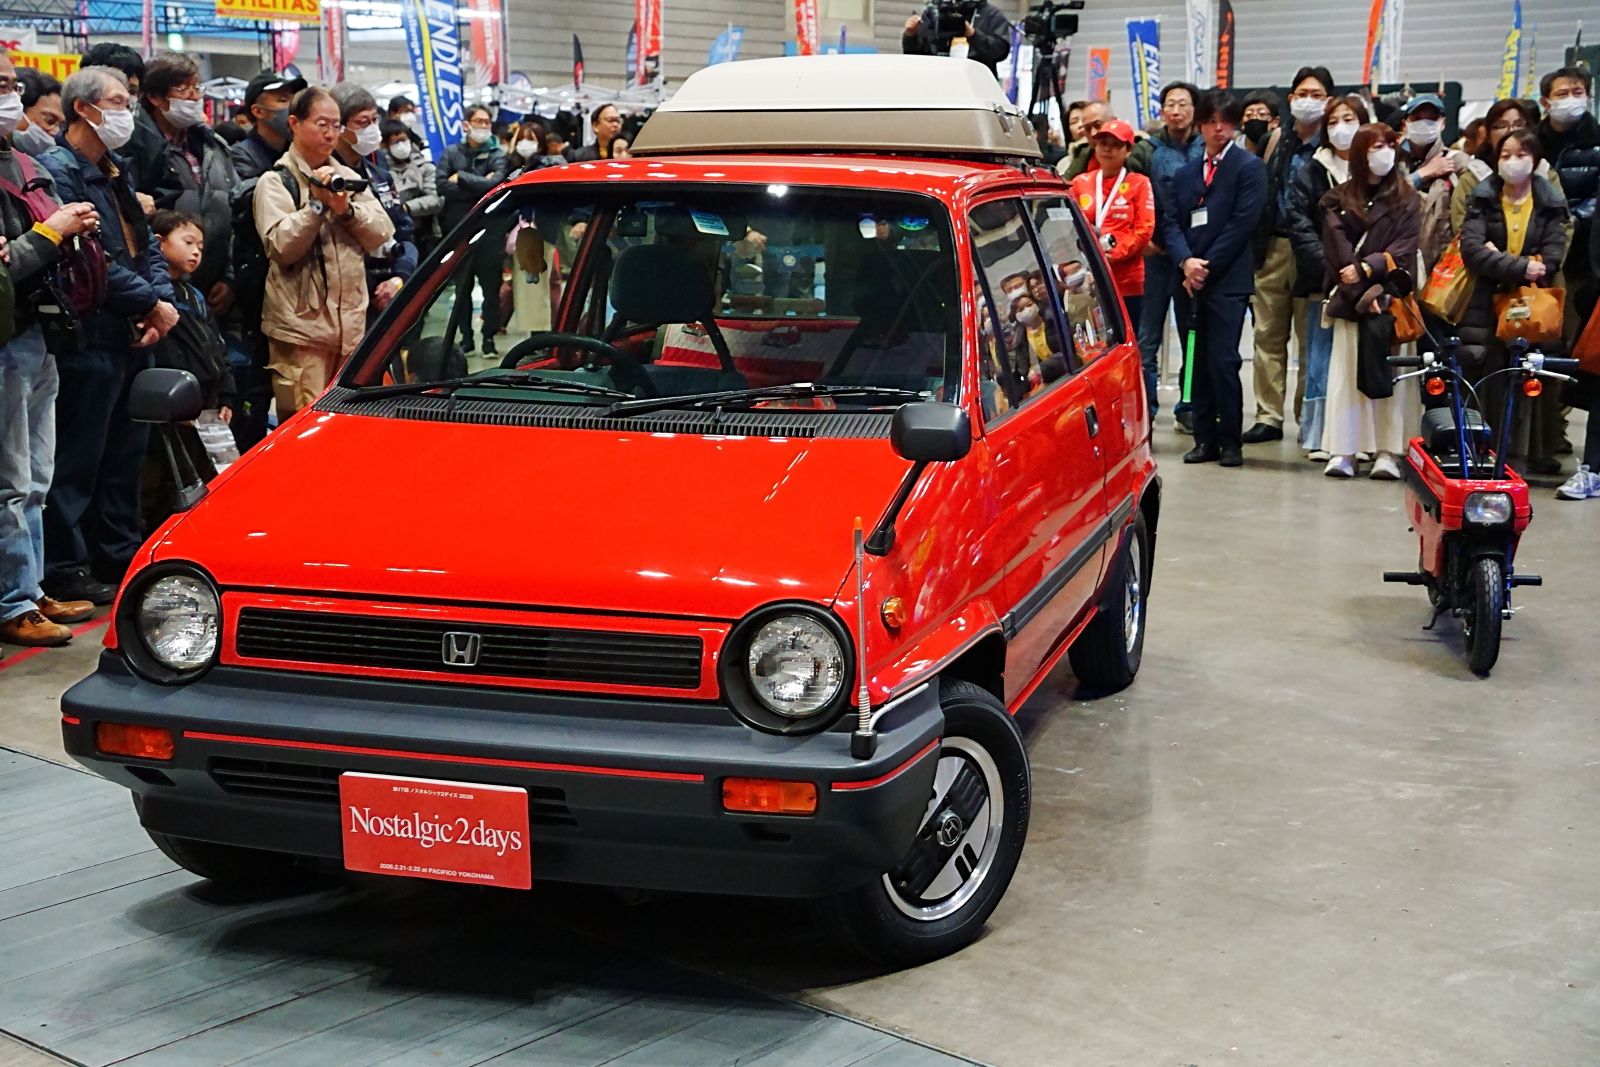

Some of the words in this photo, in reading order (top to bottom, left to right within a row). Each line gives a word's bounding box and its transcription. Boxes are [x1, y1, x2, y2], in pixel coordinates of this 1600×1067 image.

[415, 58, 423, 71] to
[424, 0, 465, 137] ENDLESS
[418, 72, 428, 93] the
[423, 95, 436, 134] Future
[349, 806, 453, 848] Nostalgic
[455, 817, 522, 857] 2days
[428, 867, 457, 876] PACIFICO
[457, 870, 495, 880] YOKOHAMA
